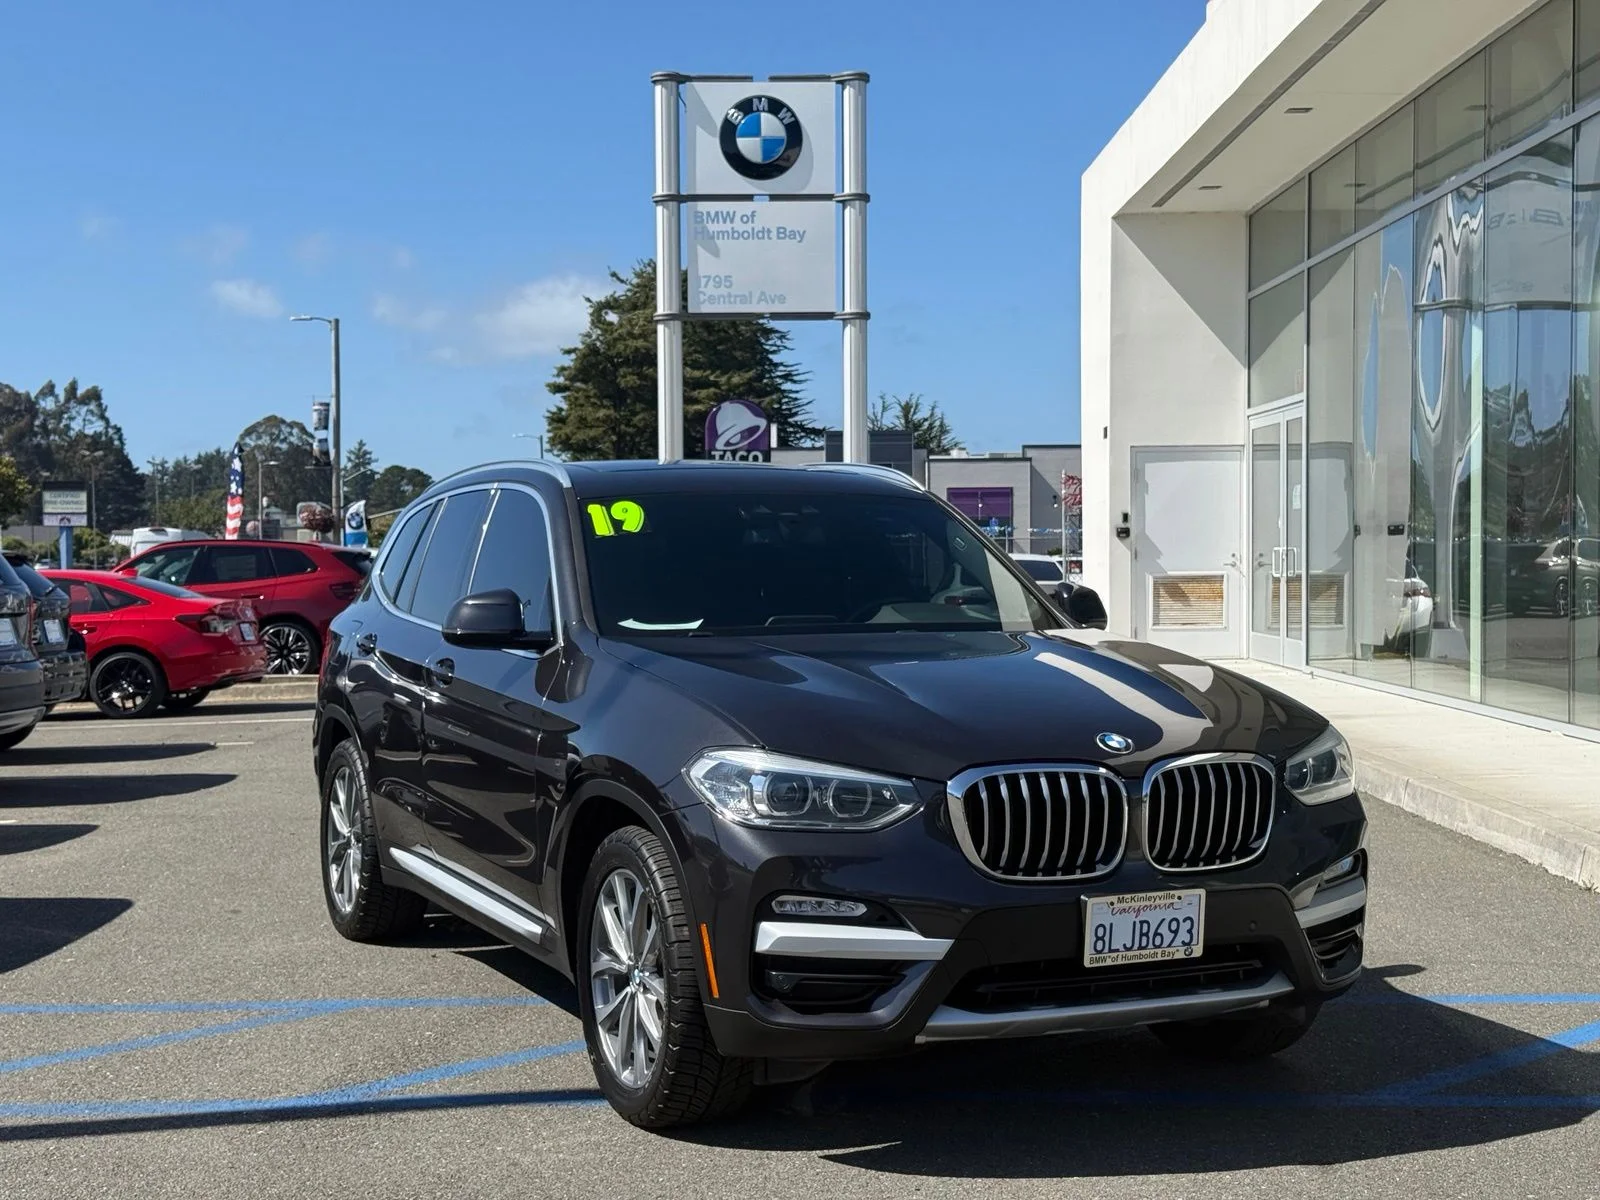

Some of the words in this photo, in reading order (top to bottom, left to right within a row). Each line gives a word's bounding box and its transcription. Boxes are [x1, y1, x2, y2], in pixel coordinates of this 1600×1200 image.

[726, 98, 795, 125] BMW
[694, 211, 736, 224] BMW
[740, 211, 757, 224] of
[694, 227, 772, 240] Humboldt
[776, 227, 806, 243] Bay
[698, 291, 753, 305] Central
[756, 291, 787, 304] Ave
[711, 451, 763, 462] TACO
[588, 501, 644, 536] 19
[1116, 893, 1175, 904] McKinleyville
[1110, 902, 1182, 919] California
[1093, 916, 1195, 953] 8LJB693
[1111, 953, 1119, 963] of
[1121, 949, 1158, 962] Humboldt
[1161, 950, 1176, 959] Bay
